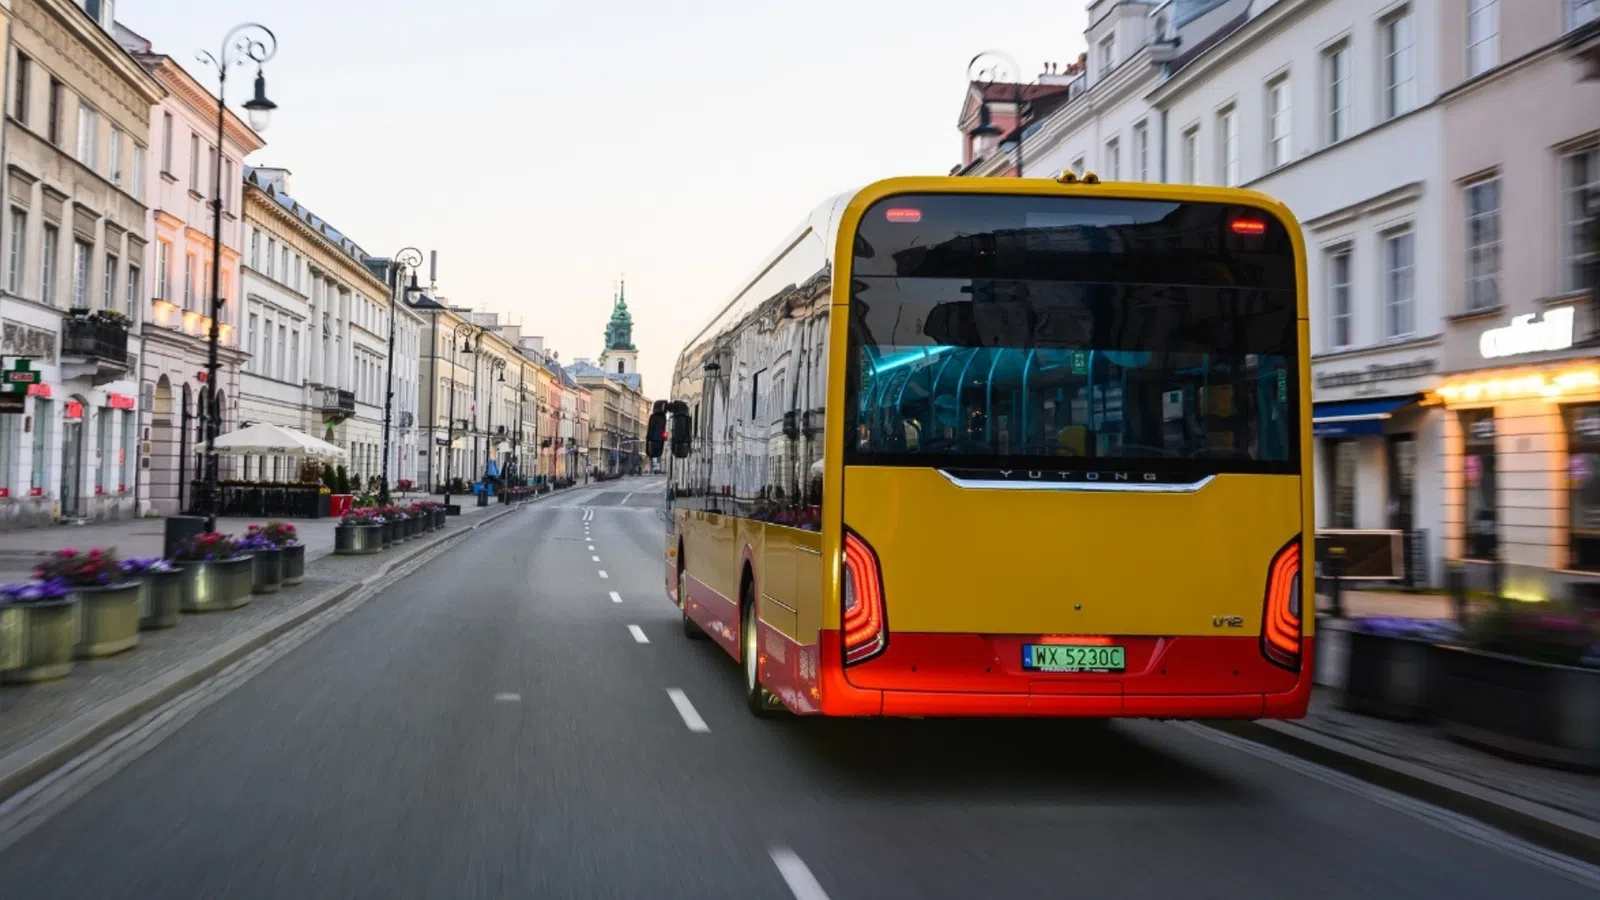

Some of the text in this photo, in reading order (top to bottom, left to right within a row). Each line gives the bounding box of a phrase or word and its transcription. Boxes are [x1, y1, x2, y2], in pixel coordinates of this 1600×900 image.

[1000, 470, 1157, 481] YUTONG
[1036, 647, 1120, 667] WX 5230C
